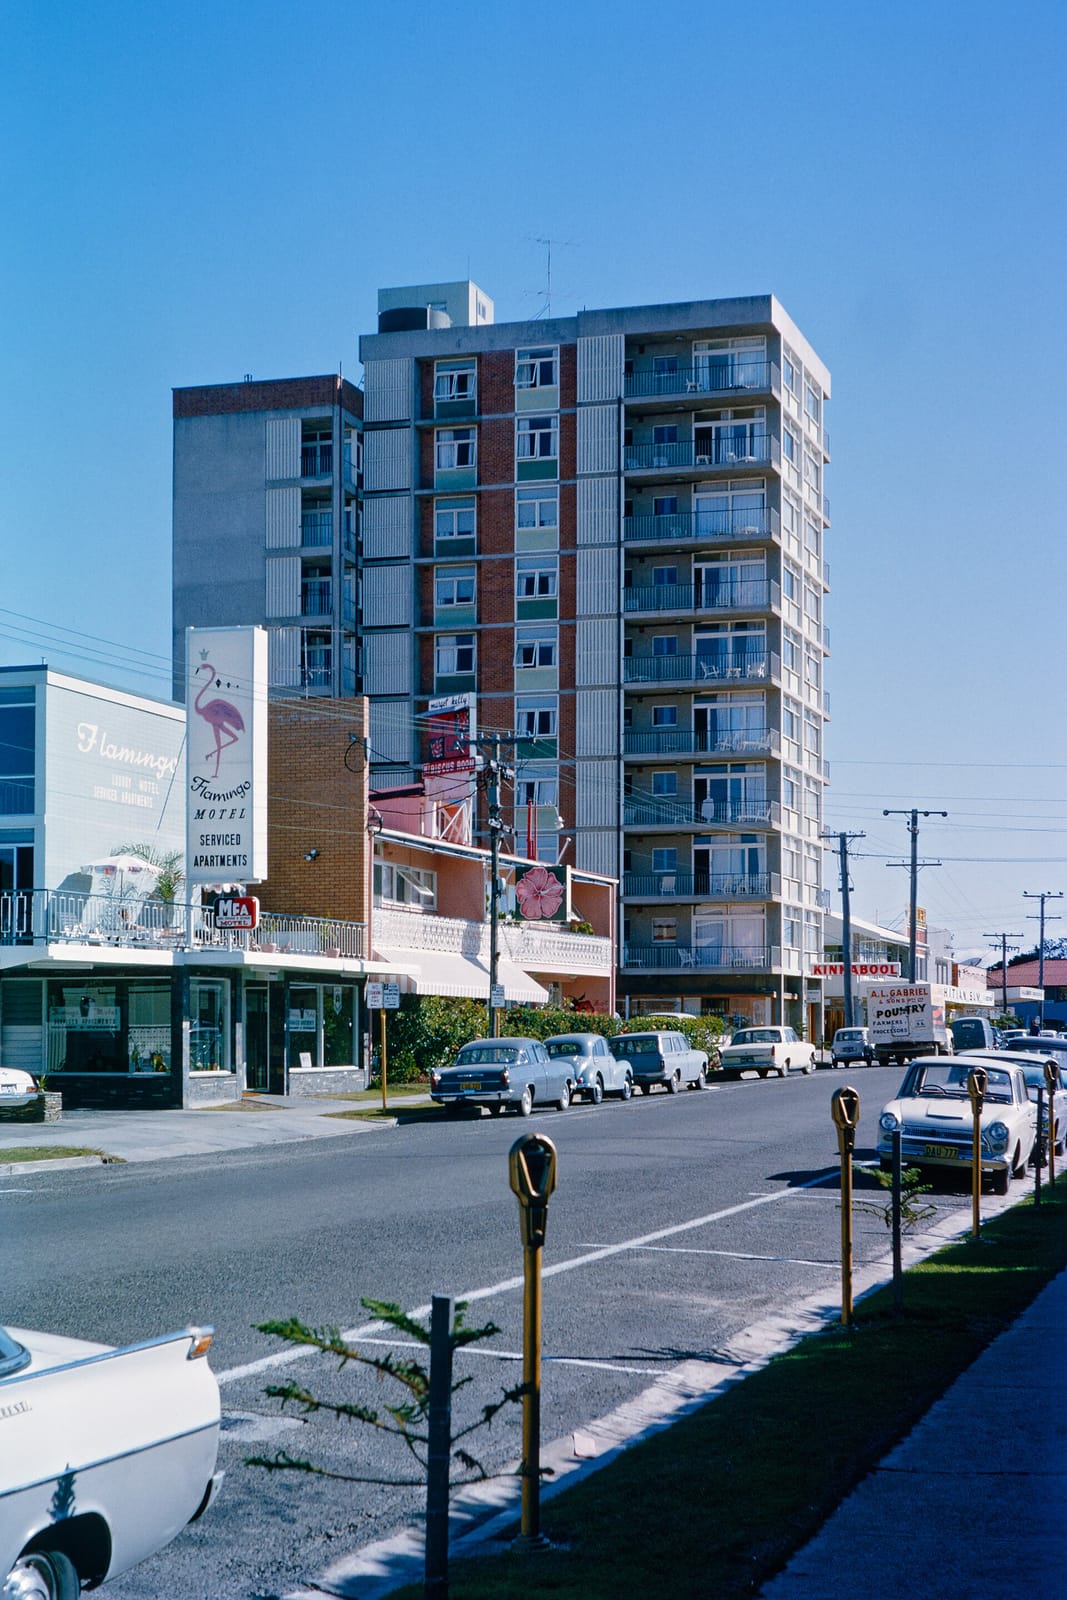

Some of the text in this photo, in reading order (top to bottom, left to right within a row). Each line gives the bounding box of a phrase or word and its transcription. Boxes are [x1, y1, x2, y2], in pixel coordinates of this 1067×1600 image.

[451, 695, 467, 705] kelly
[77, 722, 178, 779] Flamingo
[423, 758, 475, 774] HIBISCUS ROOM
[190, 776, 251, 802] Flamingo
[194, 808, 246, 820] MOTEL
[199, 833, 241, 846] SERVICED
[193, 854, 247, 867] APARTMENTS
[876, 1003, 926, 1019] POULTRY
[873, 1027, 908, 1035] PROCESSORS
